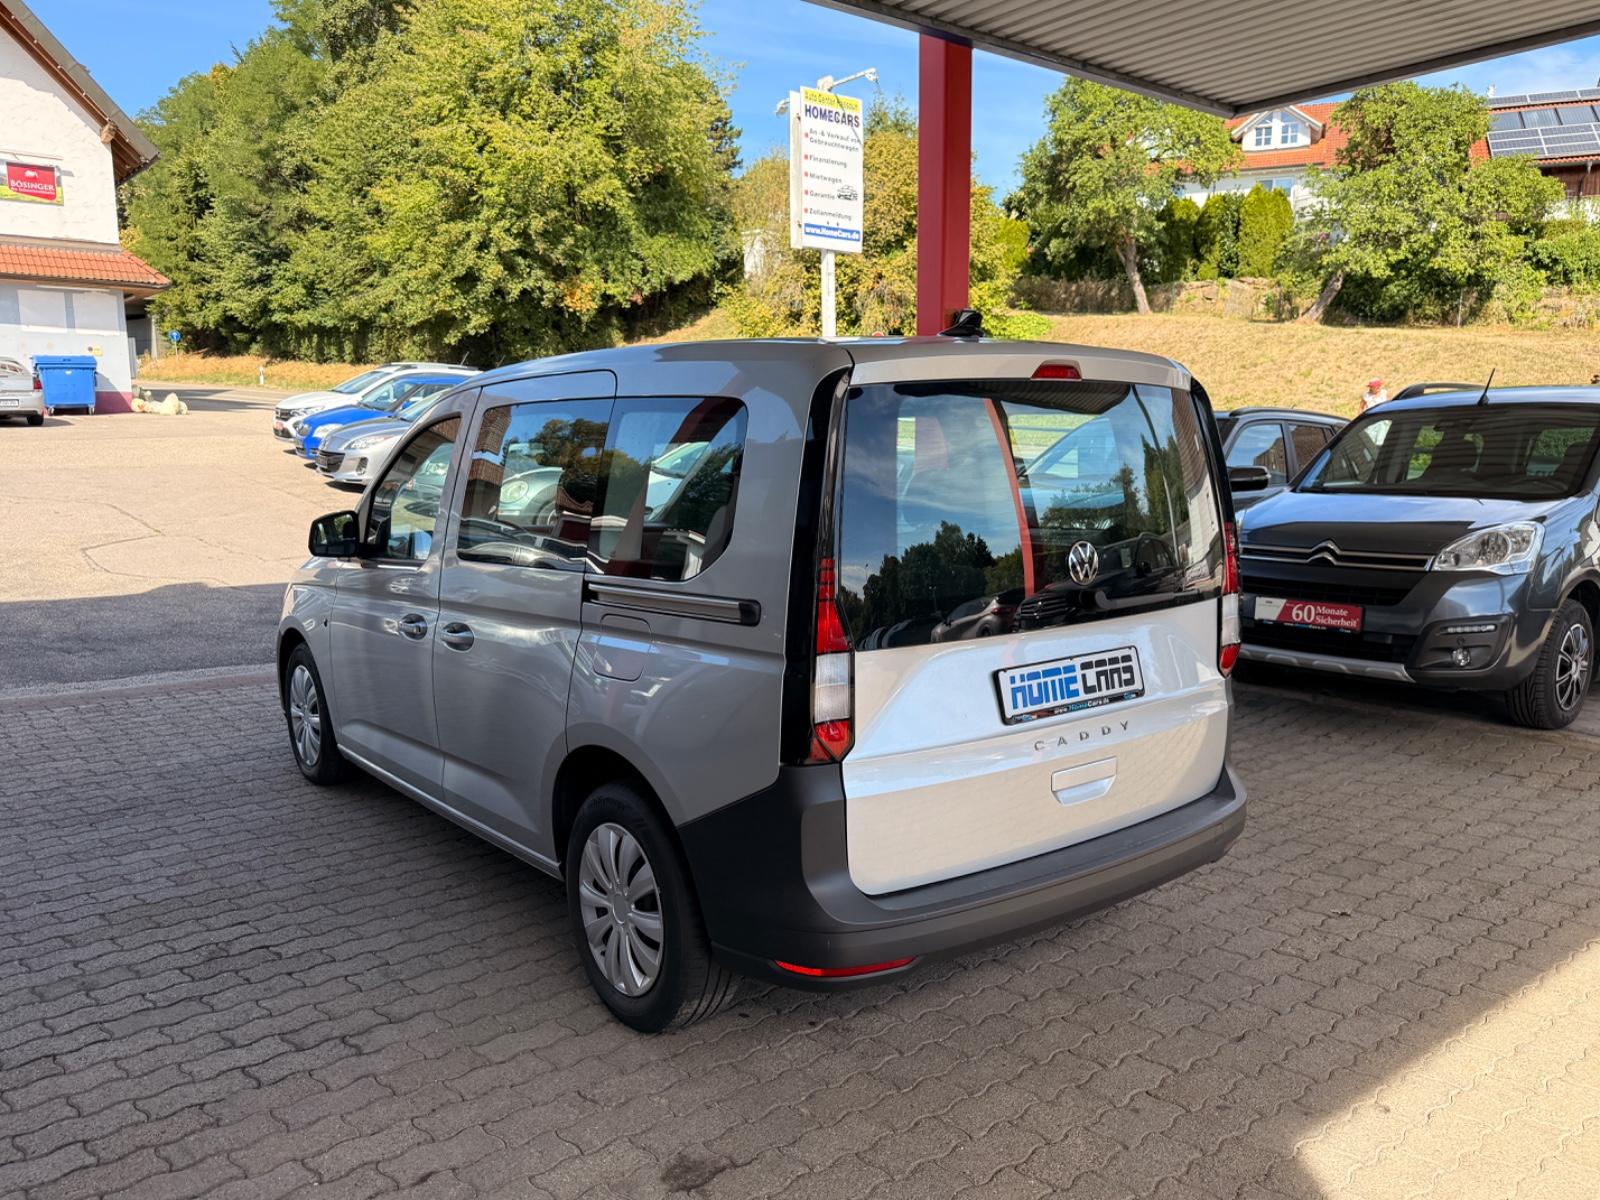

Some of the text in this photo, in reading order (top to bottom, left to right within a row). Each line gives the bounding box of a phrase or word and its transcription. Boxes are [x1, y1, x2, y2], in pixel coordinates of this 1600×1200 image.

[804, 104, 860, 128] HOMECARS
[809, 154, 848, 169] Finanzierung
[809, 171, 843, 184] Mietwagen
[809, 189, 836, 200] Garantie
[1291, 603, 1349, 623] 60 Monate
[1034, 720, 1129, 751] CADDY
